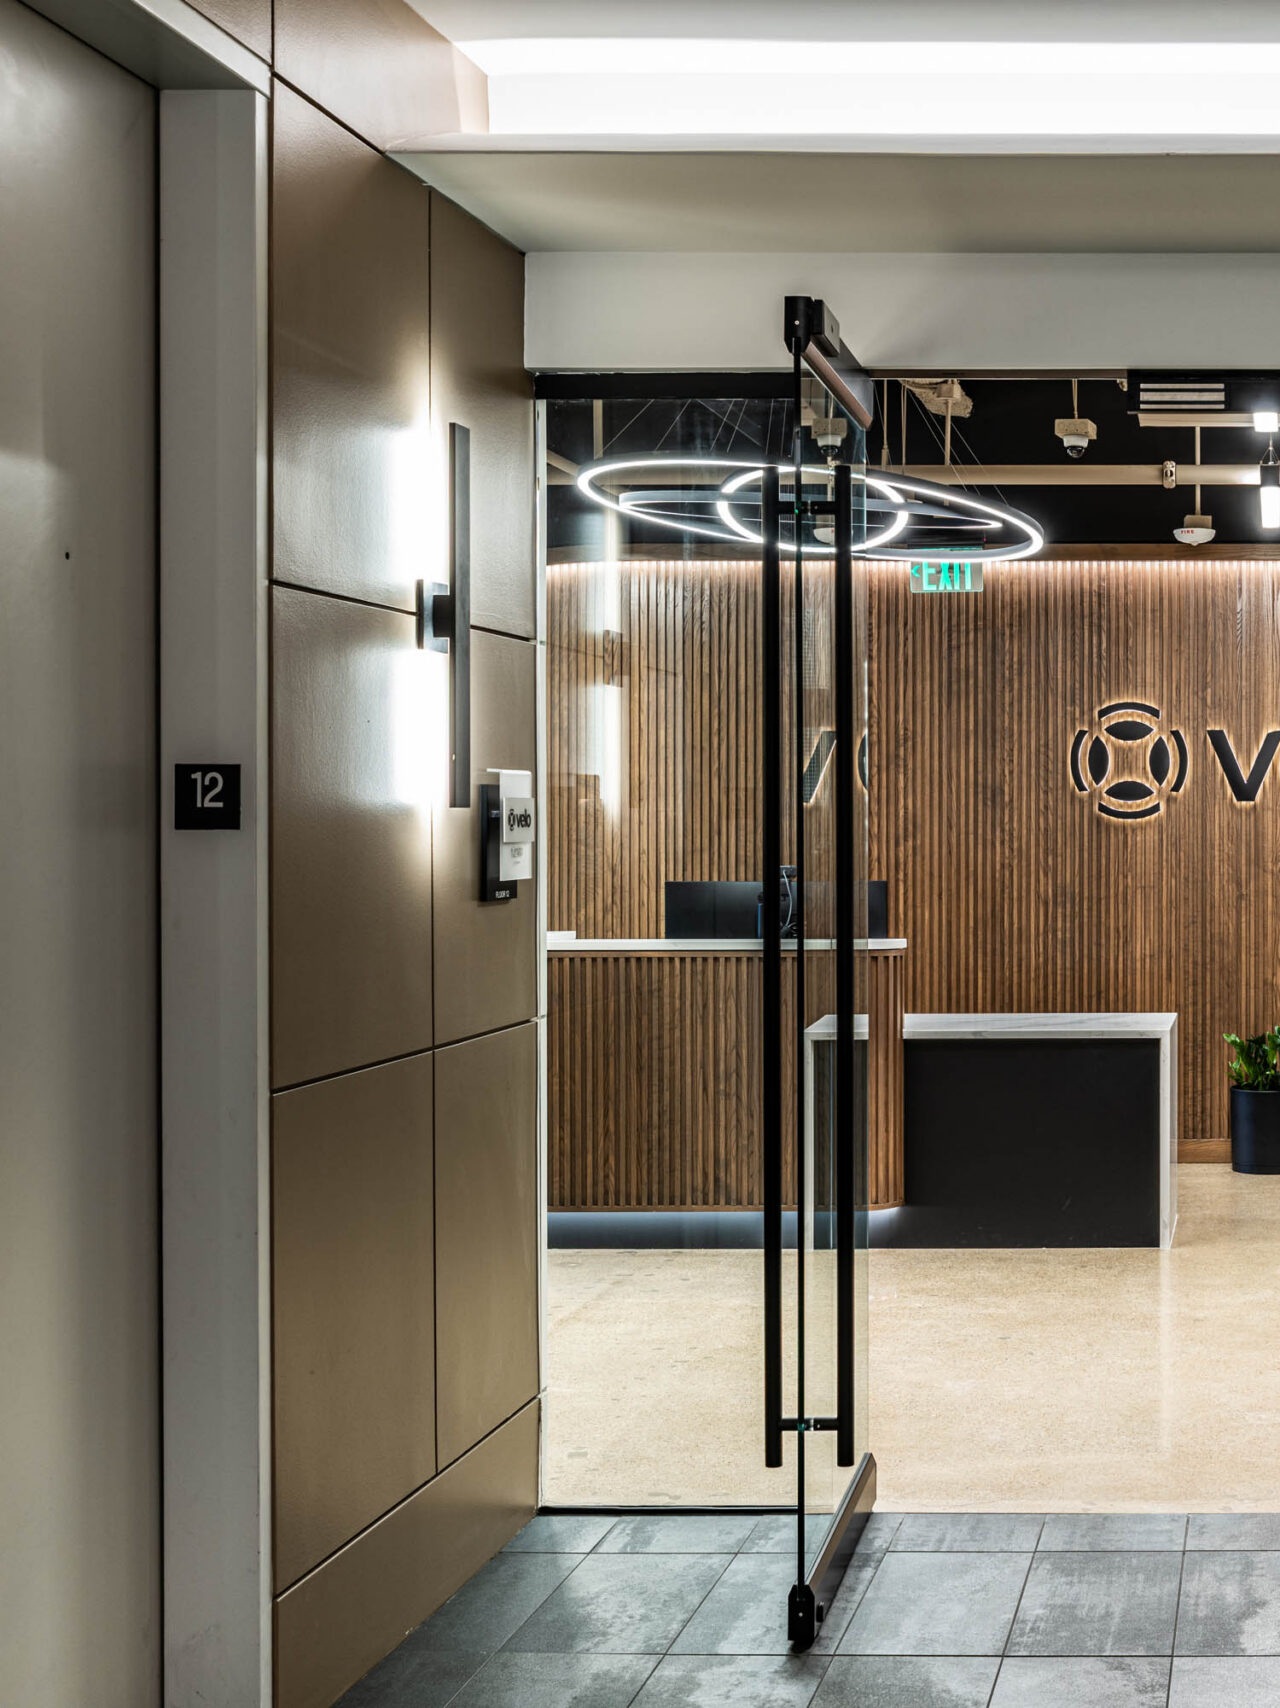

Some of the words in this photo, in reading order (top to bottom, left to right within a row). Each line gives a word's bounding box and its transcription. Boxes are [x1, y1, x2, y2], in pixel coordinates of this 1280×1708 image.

[922, 560, 972, 591] EXIT
[191, 771, 224, 808] 12
[516, 808, 532, 828] velo
